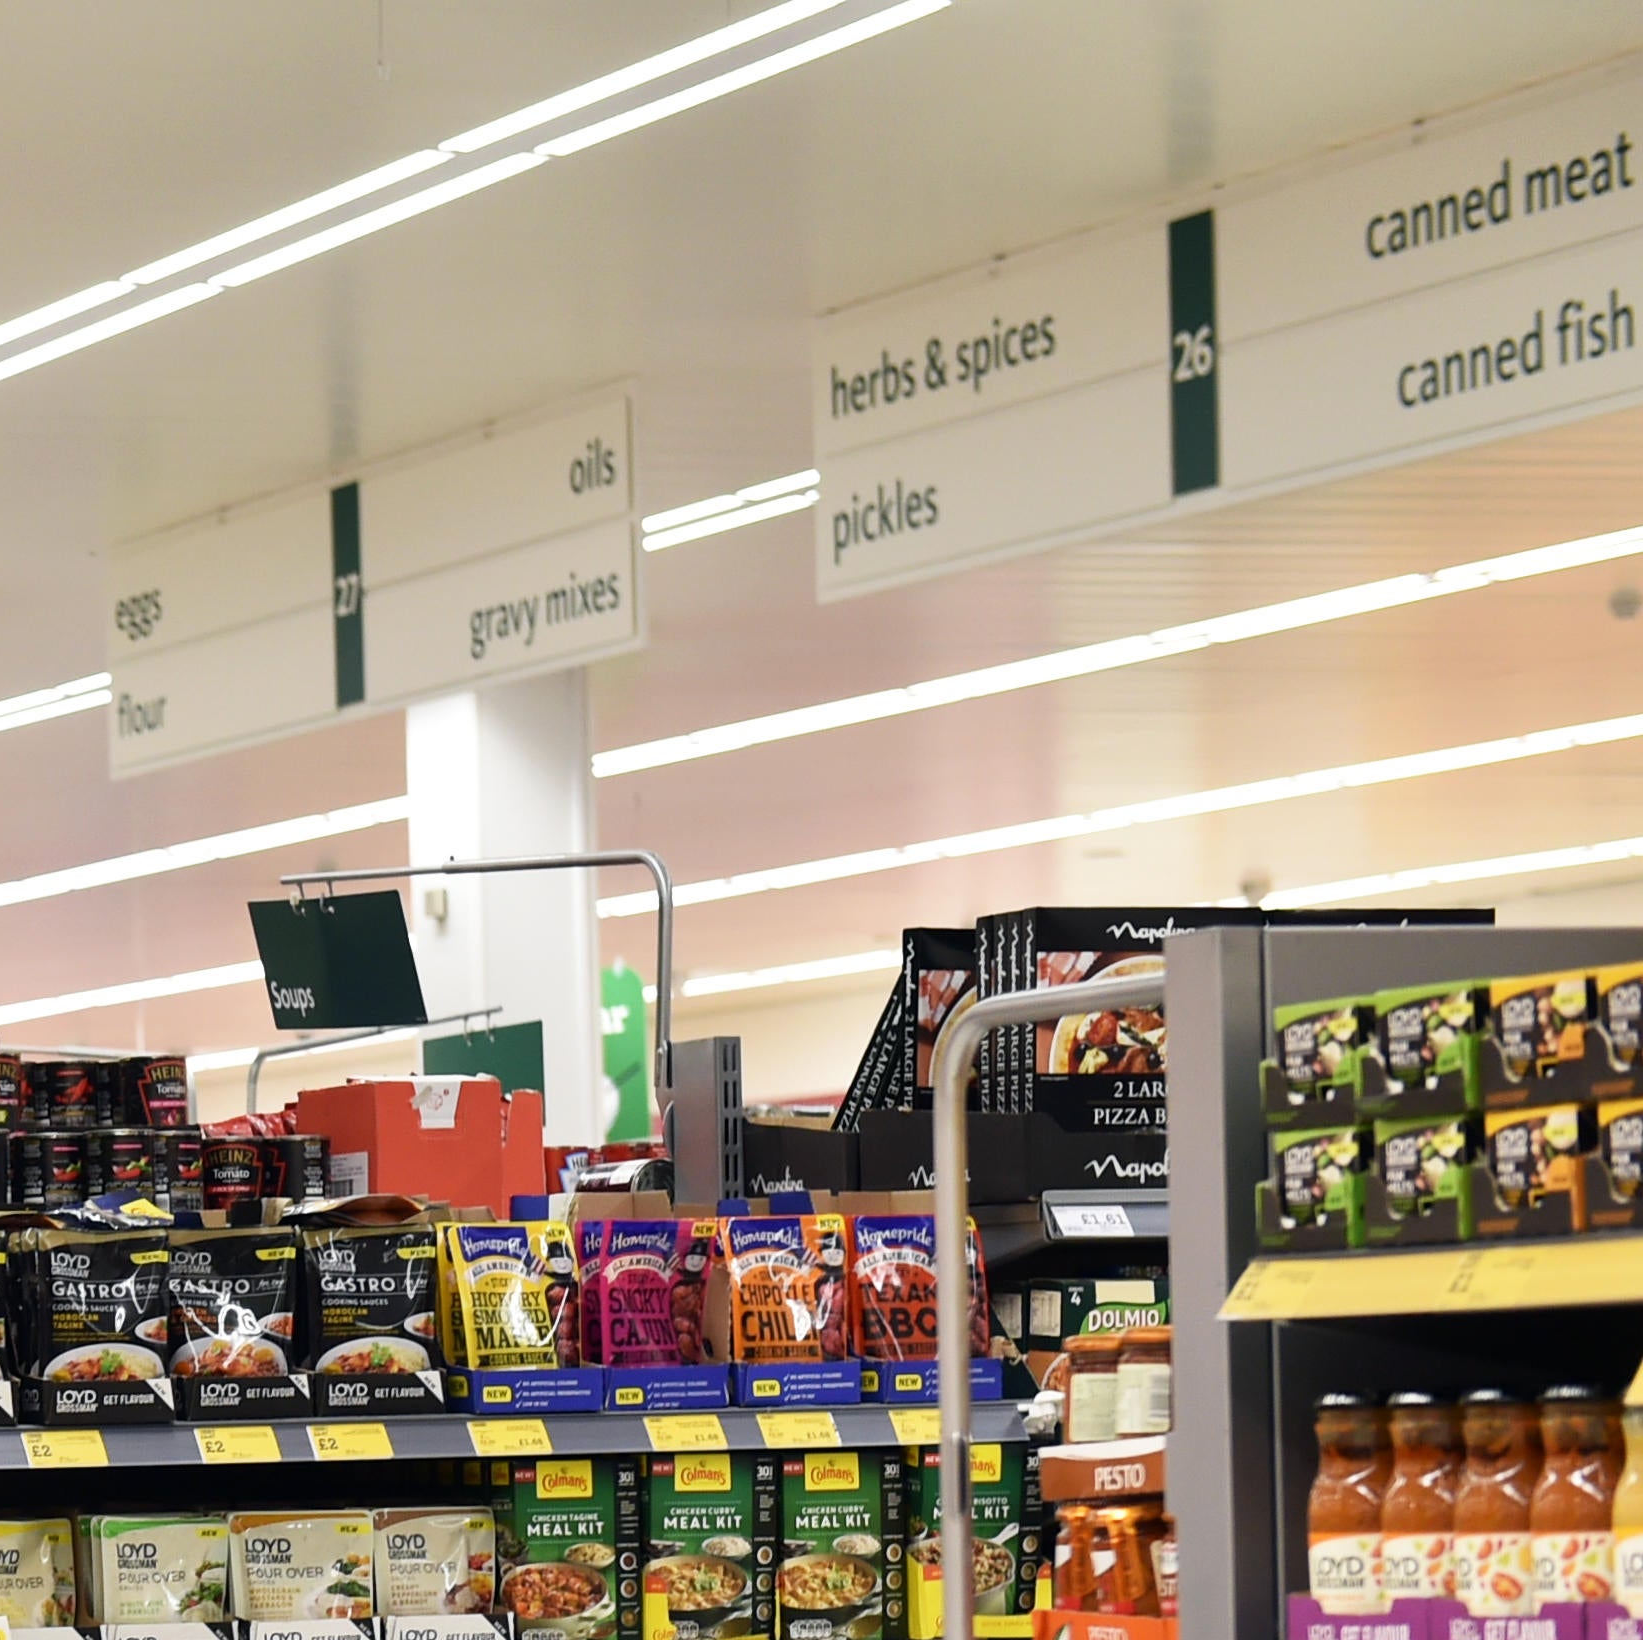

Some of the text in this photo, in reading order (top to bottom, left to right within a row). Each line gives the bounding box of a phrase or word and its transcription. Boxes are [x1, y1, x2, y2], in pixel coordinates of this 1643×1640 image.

[1366, 131, 1633, 259] canned meat
[1173, 324, 1212, 383] 26
[1398, 290, 1635, 407] canned fish
[831, 313, 1056, 420] herbs & spices
[571, 438, 615, 494] oils
[833, 478, 938, 564] pickles
[335, 573, 361, 618] 27
[117, 590, 161, 641] eggs
[470, 573, 619, 659] gravy mixes
[119, 693, 166, 738] flour
[270, 981, 316, 1018] Soups
[1115, 1082, 1168, 1097] 2 LAR
[1094, 1108, 1149, 1124] PIZZA
[214, 1139, 254, 1164] HEINZ
[213, 1166, 251, 1181] Tomato
[1081, 1213, 1126, 1225] £1.61
[695, 1225, 714, 1234] NEW
[858, 1226, 932, 1248] Homepride
[612, 1231, 670, 1251] Homepride
[51, 1251, 90, 1267] LOYD
[169, 1251, 211, 1266] LOYD
[51, 1266, 89, 1278] GROSSMAN
[52, 1281, 125, 1297] GASTRO
[170, 1279, 250, 1293] GASTRO
[321, 1277, 395, 1292] GASTRO
[609, 1288, 666, 1314] SMOKY
[1088, 1308, 1159, 1332] DOLMIO
[611, 1319, 677, 1347] CAJUN
[200, 1384, 295, 1399] LOYD GET FLAVOUR
[487, 1390, 508, 1399] NEW
[619, 1392, 640, 1400] NEW
[756, 1384, 776, 1393] NEW
[56, 1390, 155, 1406] LOYD GET FLAVOUR
[32, 1444, 52, 1457] £2
[206, 1440, 223, 1453] £2
[319, 1438, 338, 1451] £2
[681, 1465, 726, 1485] Colman's
[810, 1465, 854, 1484] Colman's
[1094, 1465, 1146, 1491] PESTO
[670, 1507, 706, 1515] CHICKEN
[664, 1516, 742, 1529] MEAL KIT
[244, 1538, 291, 1553] LOYD
[247, 1567, 324, 1579] POUR OVER
